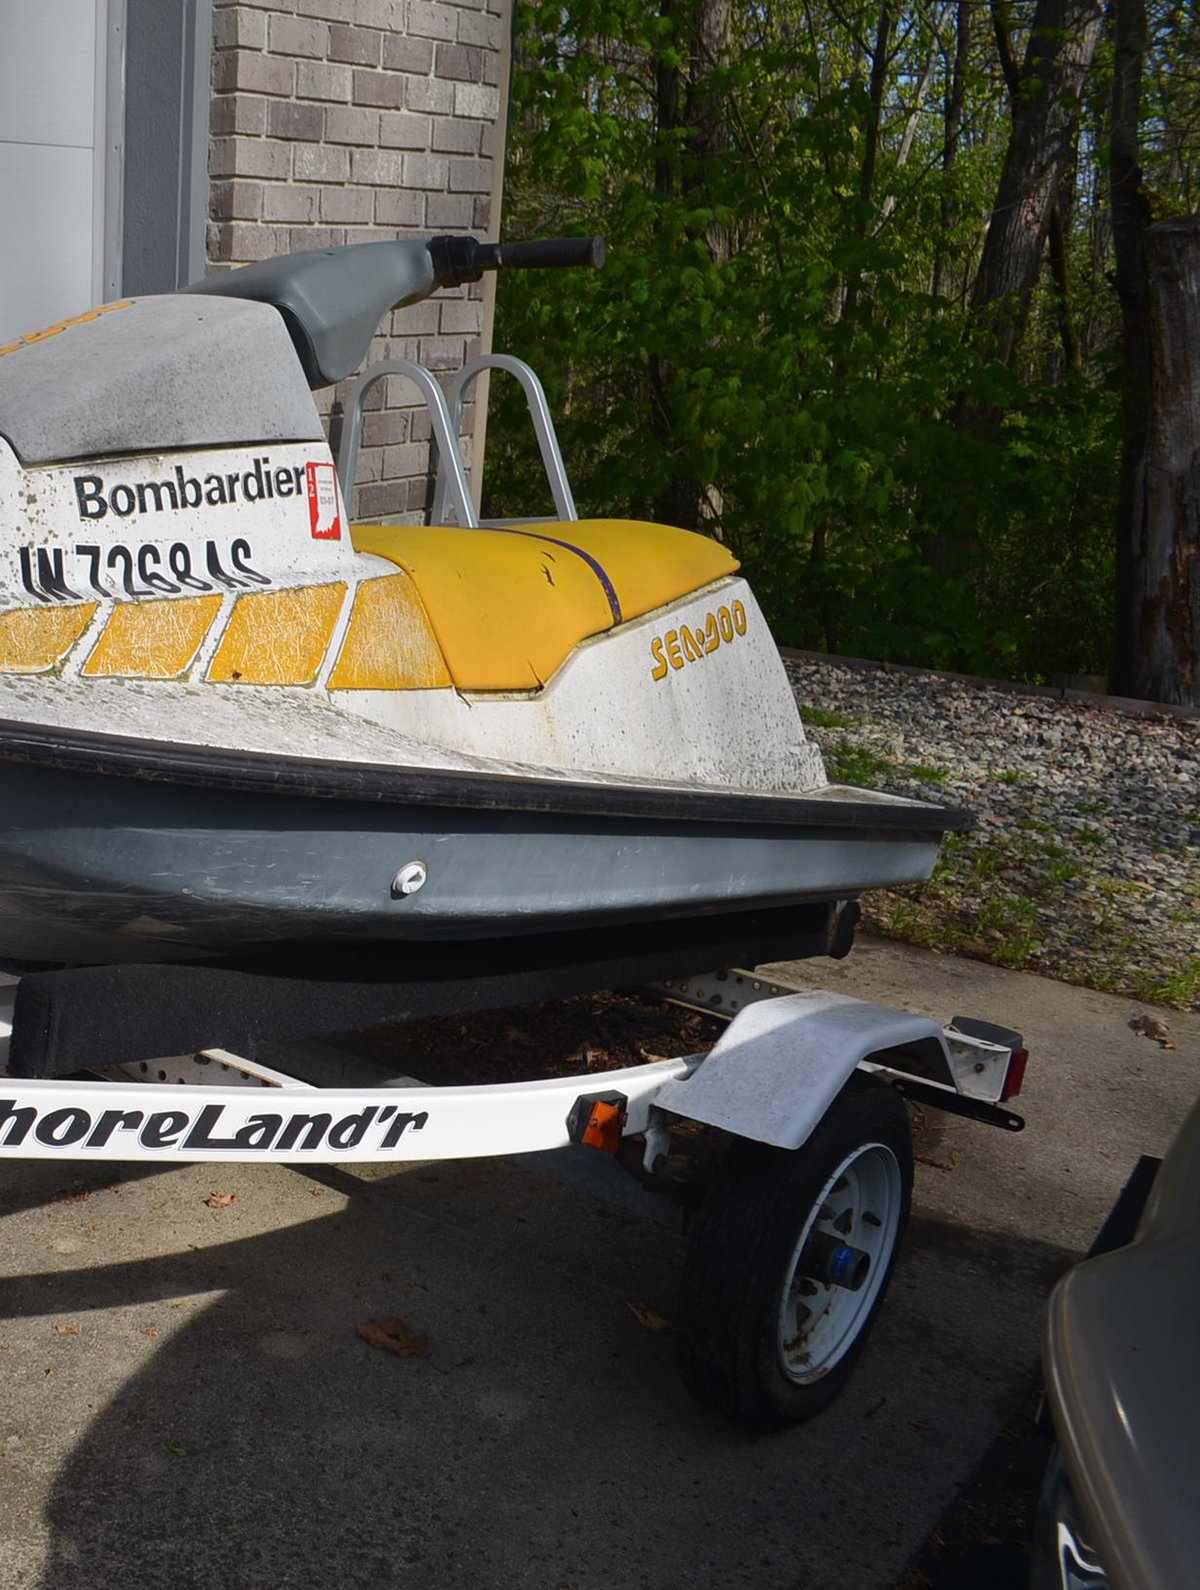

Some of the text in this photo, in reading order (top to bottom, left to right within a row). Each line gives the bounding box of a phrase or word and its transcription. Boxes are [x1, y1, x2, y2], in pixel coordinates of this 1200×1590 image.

[73, 457, 306, 521] Bombardier
[19, 537, 273, 602] IN 7268 AS
